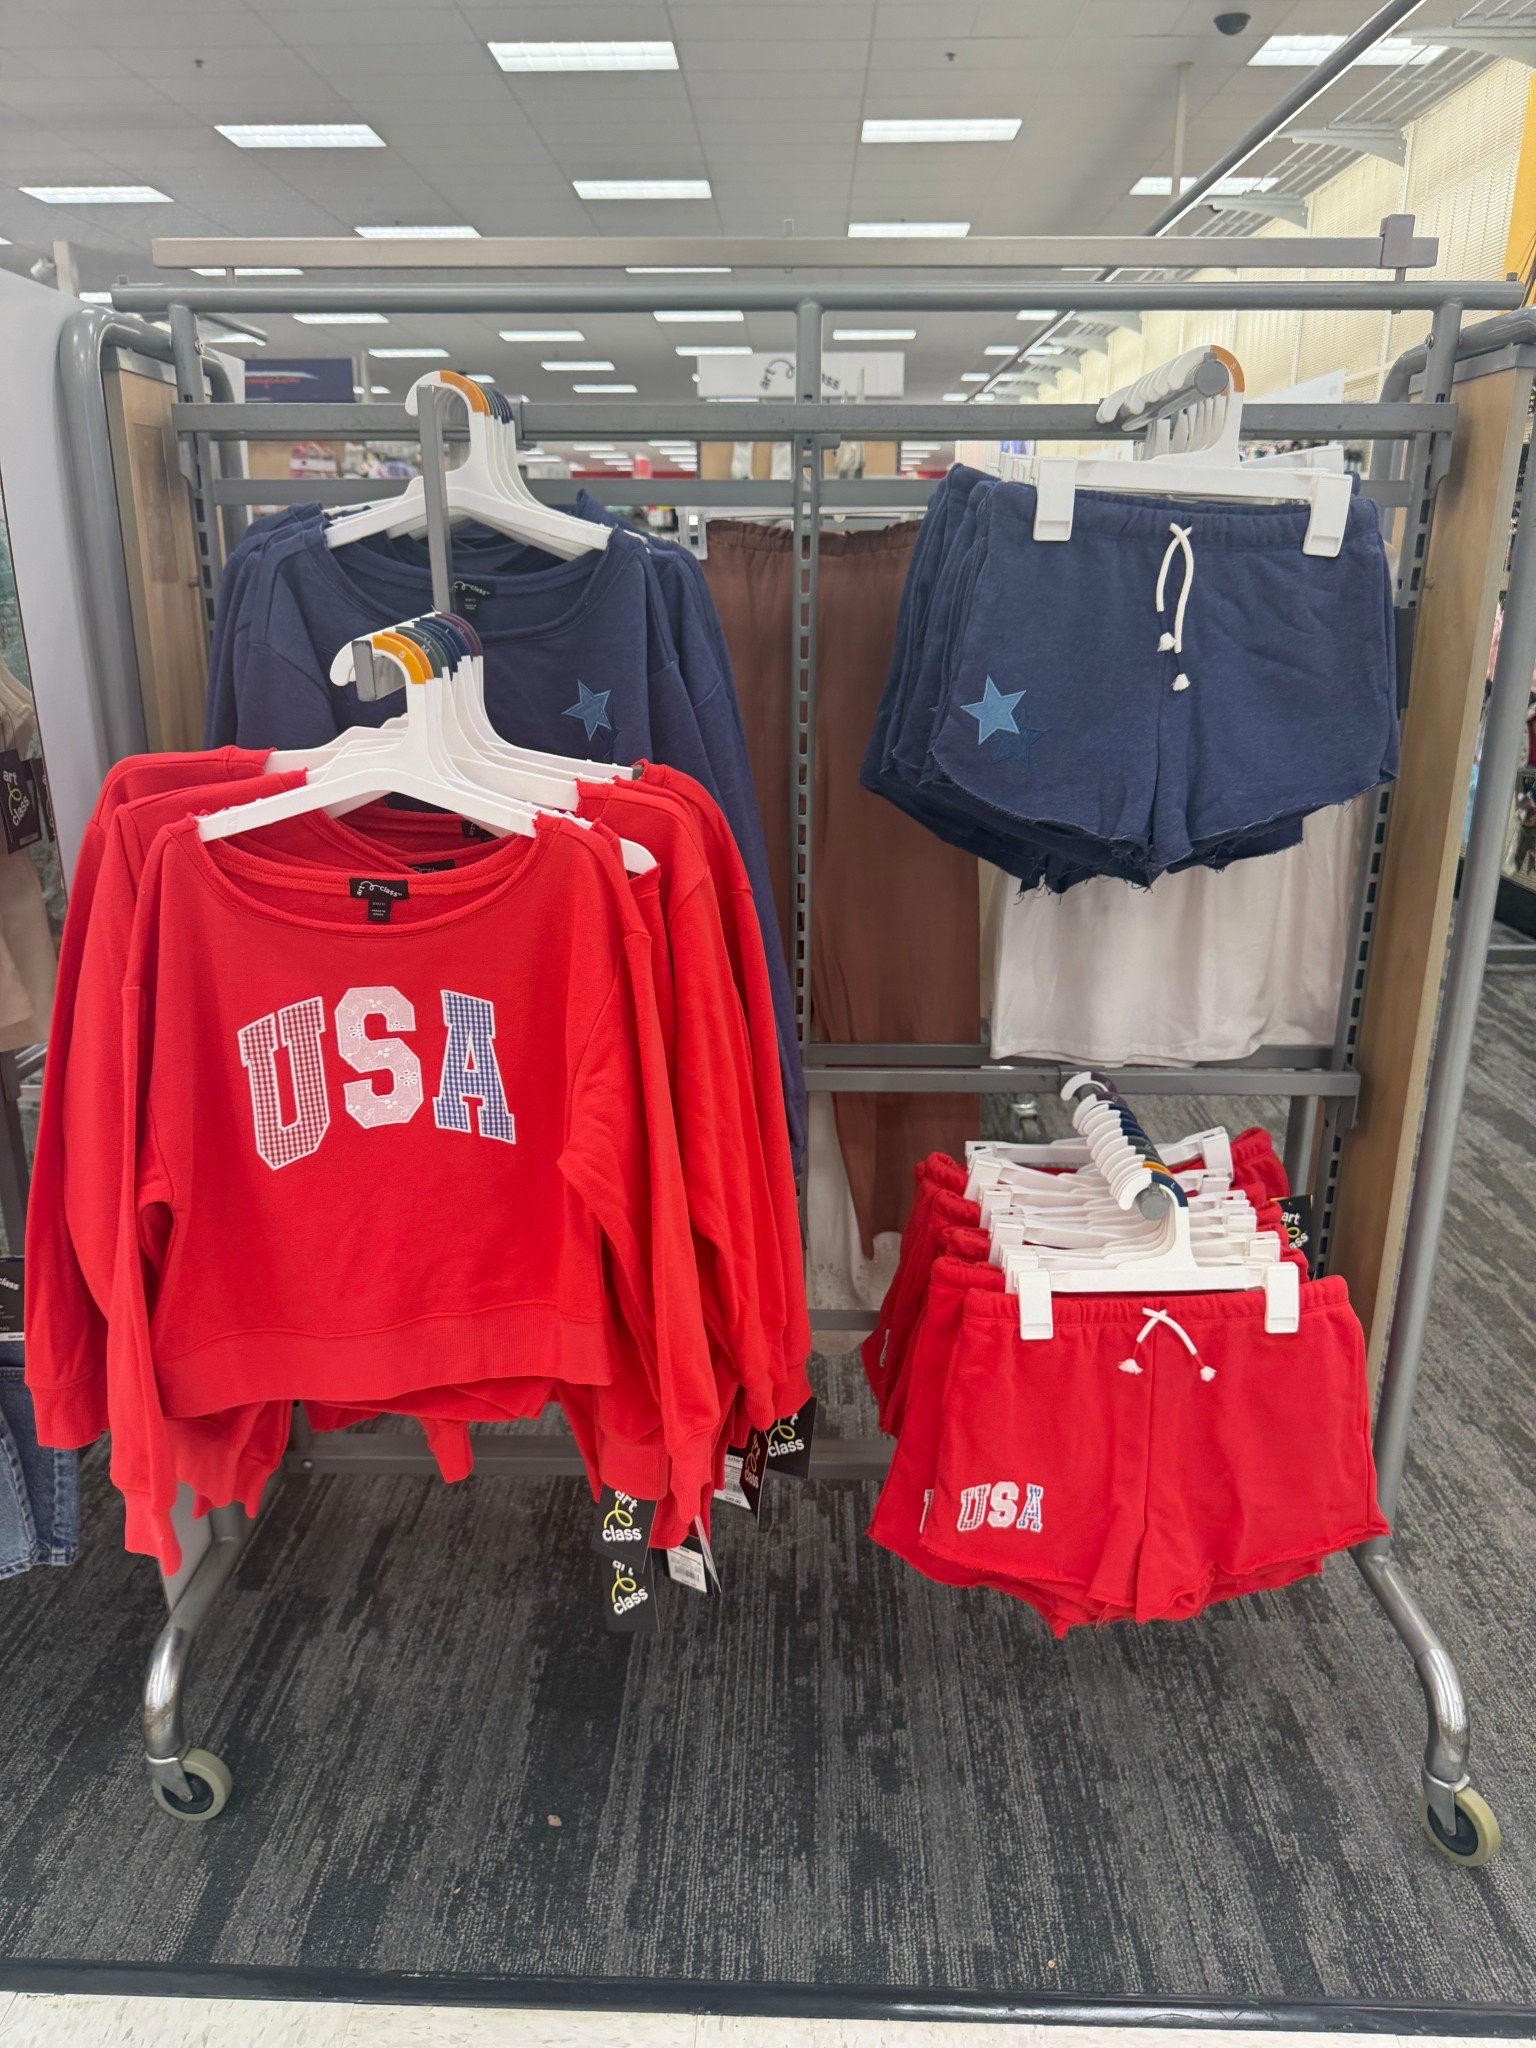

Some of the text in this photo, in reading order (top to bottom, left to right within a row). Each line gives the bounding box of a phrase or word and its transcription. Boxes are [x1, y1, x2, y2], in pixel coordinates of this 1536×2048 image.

[761, 367, 776, 390] art
[398, 649, 407, 659] S
[2, 770, 19, 786] art
[12, 796, 30, 827] class
[379, 885, 398, 898] class
[237, 986, 517, 1171] USA
[1281, 1211, 1301, 1226] art
[1288, 1232, 1309, 1249] ass
[768, 1438, 805, 1458] class
[614, 1489, 638, 1514] art
[956, 1481, 1045, 1534] USA
[602, 1524, 642, 1542] class
[613, 1587, 649, 1615] class
